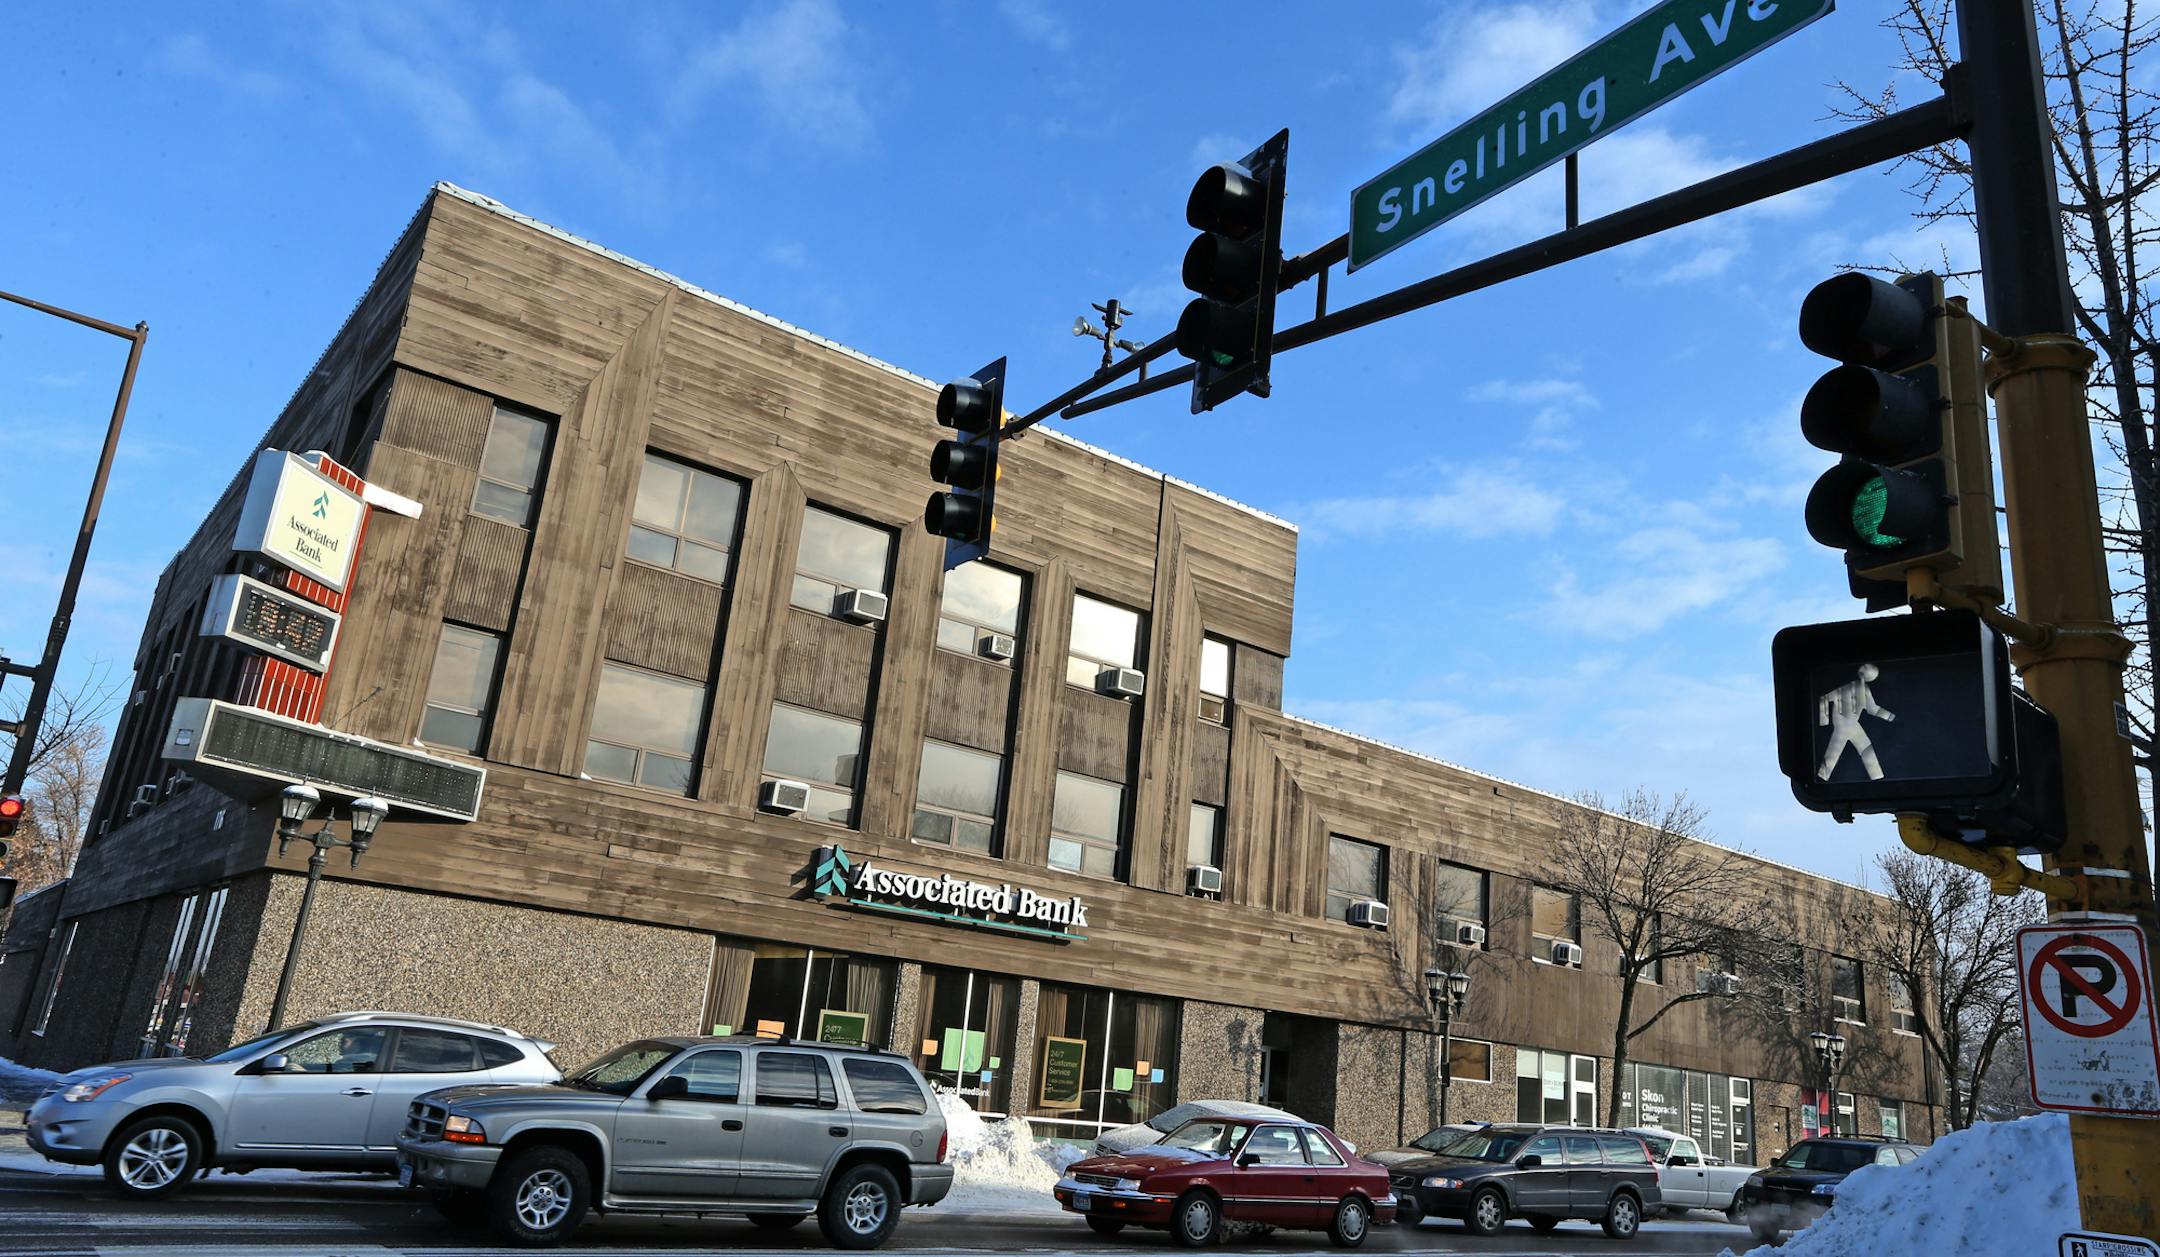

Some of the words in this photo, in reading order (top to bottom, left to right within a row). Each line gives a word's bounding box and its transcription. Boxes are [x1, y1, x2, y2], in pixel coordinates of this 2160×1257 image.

[1375, 74, 1607, 234] Snelling
[1647, 0, 1780, 85] Ave
[286, 514, 339, 553] Associated
[294, 537, 323, 564] Bank
[854, 860, 1011, 915] Associated
[1016, 887, 1089, 928] Bank
[1641, 1088, 1664, 1103] Skon
[1641, 1103, 1678, 1115] Chiropractic
[1641, 1112, 1660, 1123] Clinic
